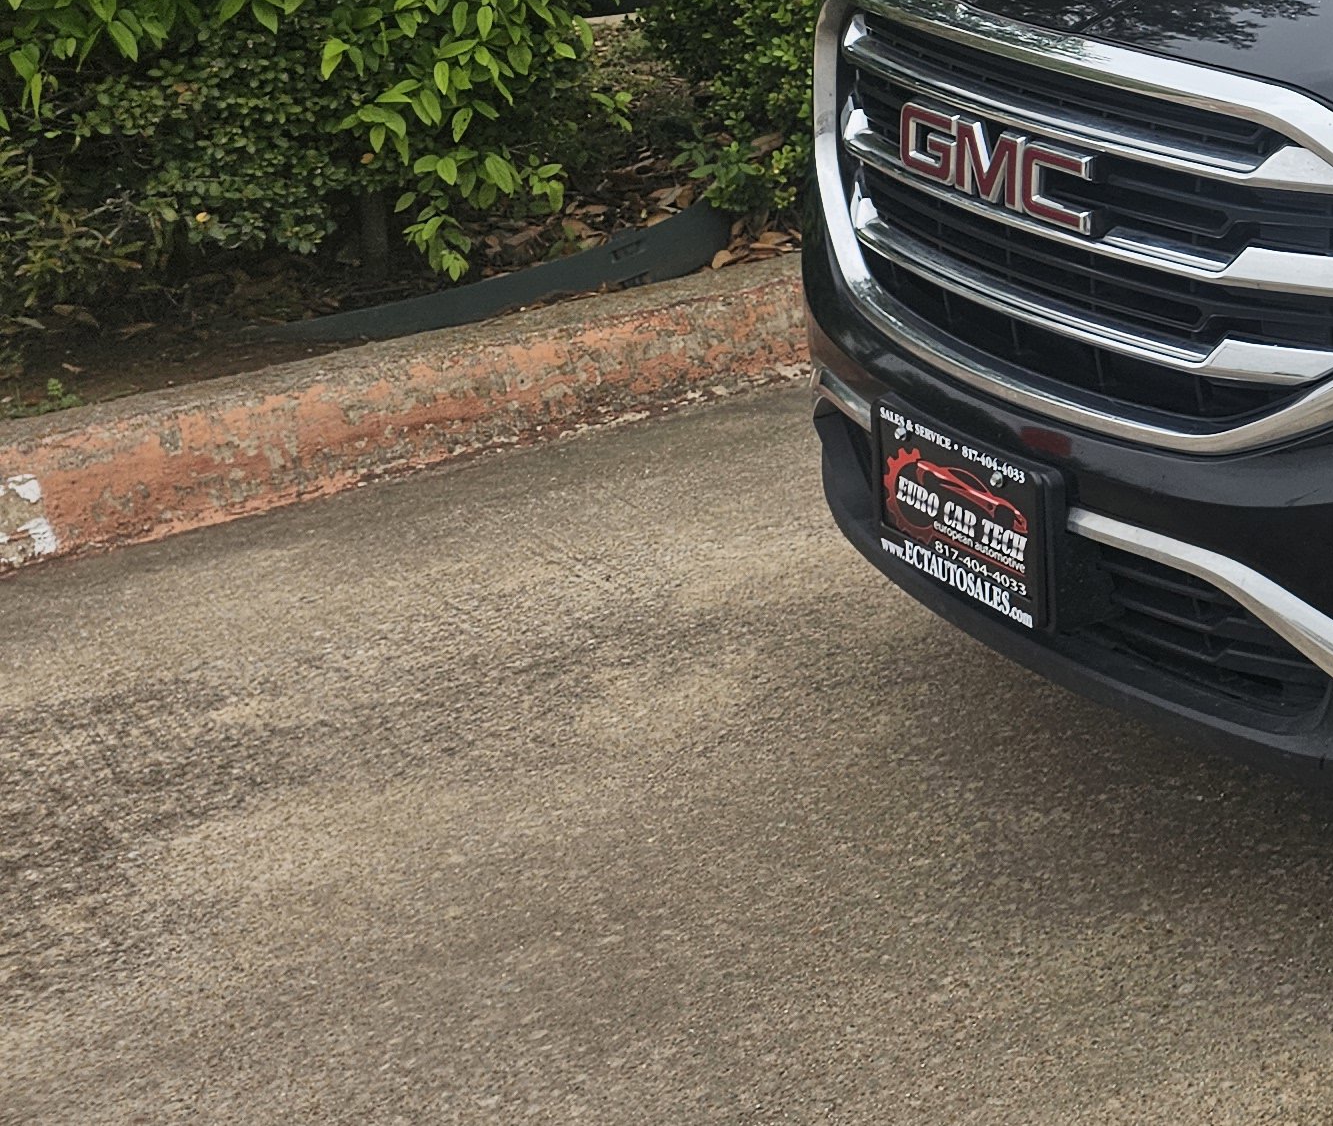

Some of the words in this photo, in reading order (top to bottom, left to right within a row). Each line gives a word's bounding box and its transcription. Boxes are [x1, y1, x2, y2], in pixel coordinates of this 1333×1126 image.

[900, 101, 1097, 235] GMC
[880, 407, 905, 427] SALES
[906, 419, 914, 432] &
[914, 423, 952, 450] SERVICE
[961, 445, 1026, 484] 817-404-4033
[896, 476, 940, 517] EURO
[943, 501, 977, 538] CAR
[981, 518, 1028, 561] TECH
[933, 520, 974, 548] european
[974, 541, 1026, 573] automotive
[880, 537, 1034, 629] www.ECTAUTOSALES.com
[934, 540, 1027, 596] 817-404-4033
